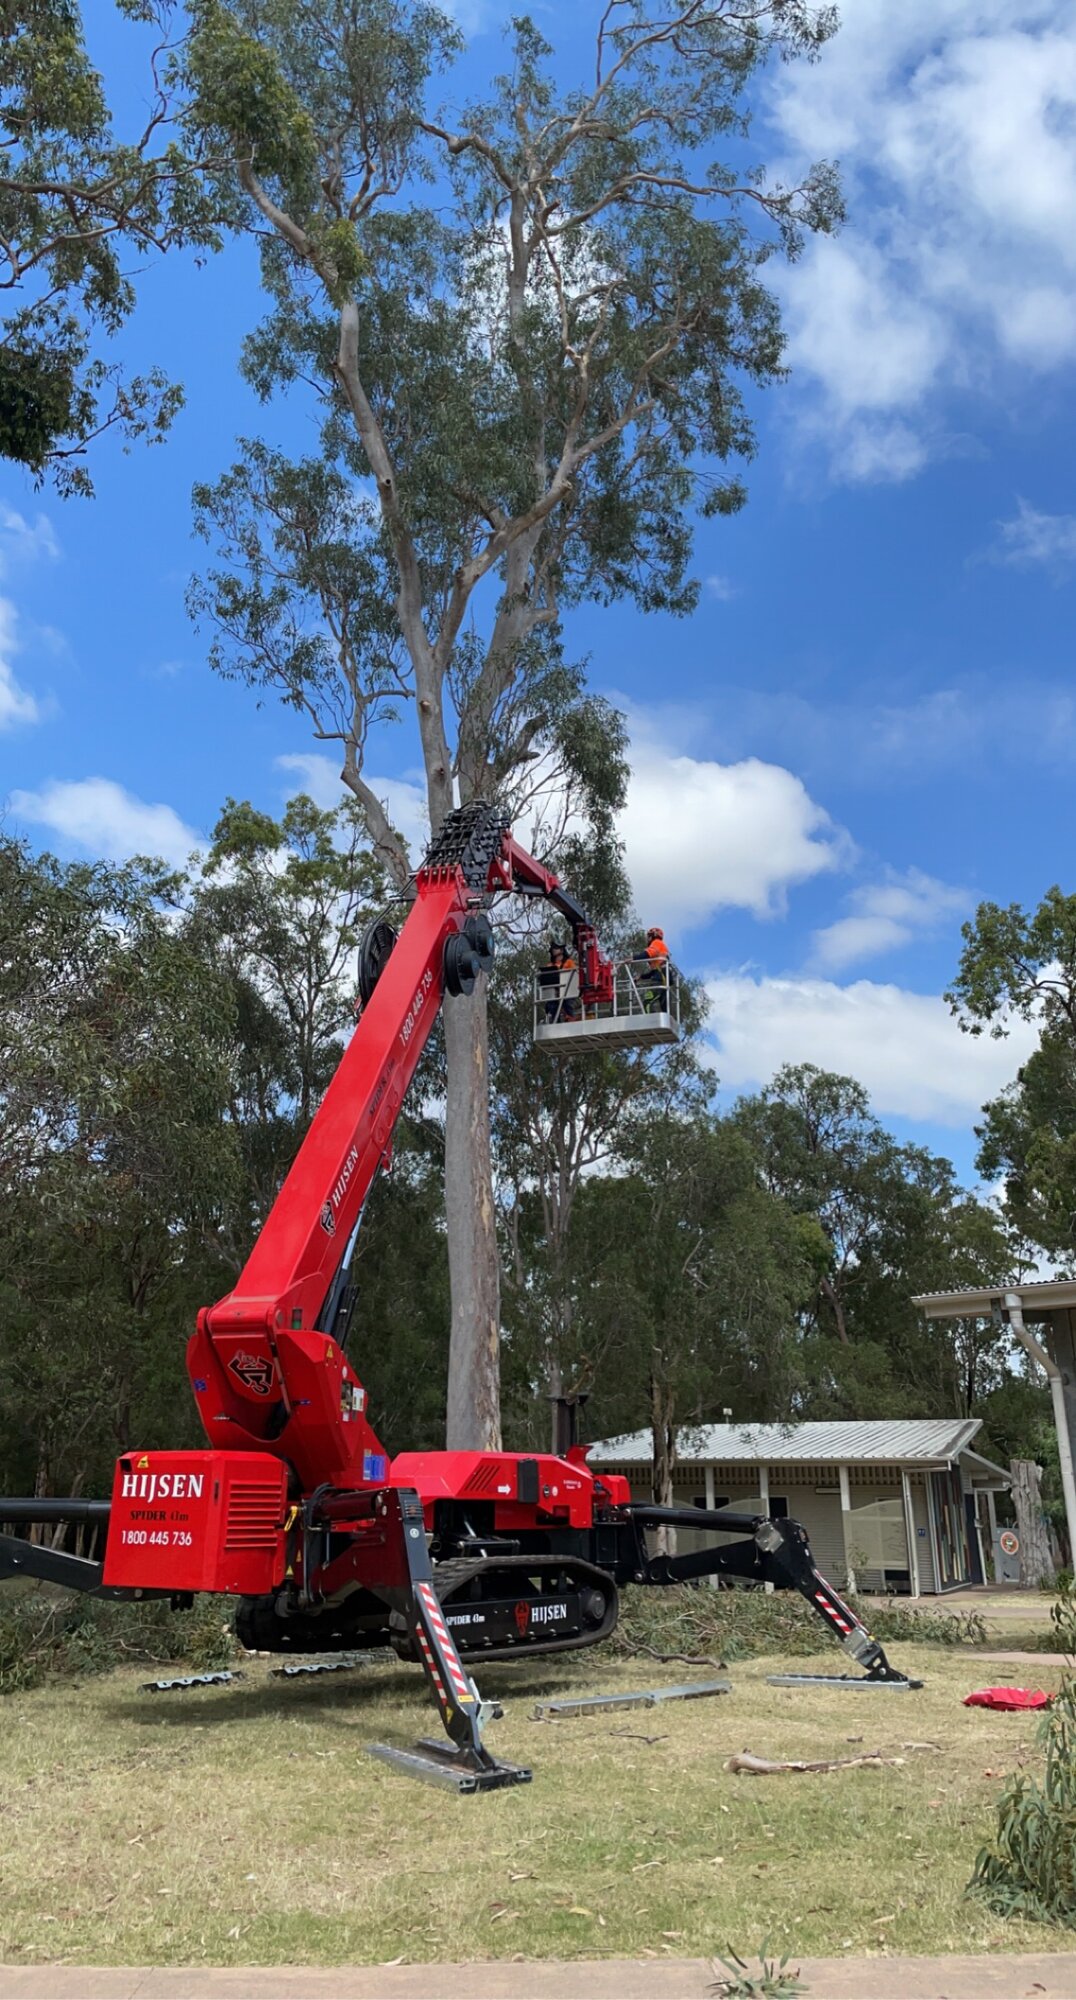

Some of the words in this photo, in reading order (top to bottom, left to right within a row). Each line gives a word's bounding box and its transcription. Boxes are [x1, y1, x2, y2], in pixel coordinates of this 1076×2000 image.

[399, 1012, 414, 1048] 1800
[412, 988, 424, 1016] 445
[421, 968, 433, 995] 736
[332, 1145, 359, 1208] HIJSEN
[121, 1474, 204, 1503] HIJSEN
[130, 1510, 167, 1521] SPIDER
[121, 1530, 147, 1545] 1800
[149, 1531, 169, 1545] 445
[172, 1532, 192, 1546] 736
[445, 1614, 471, 1626] SPIDER
[472, 1613, 485, 1623] 43m
[531, 1604, 567, 1625] HIJSEN
